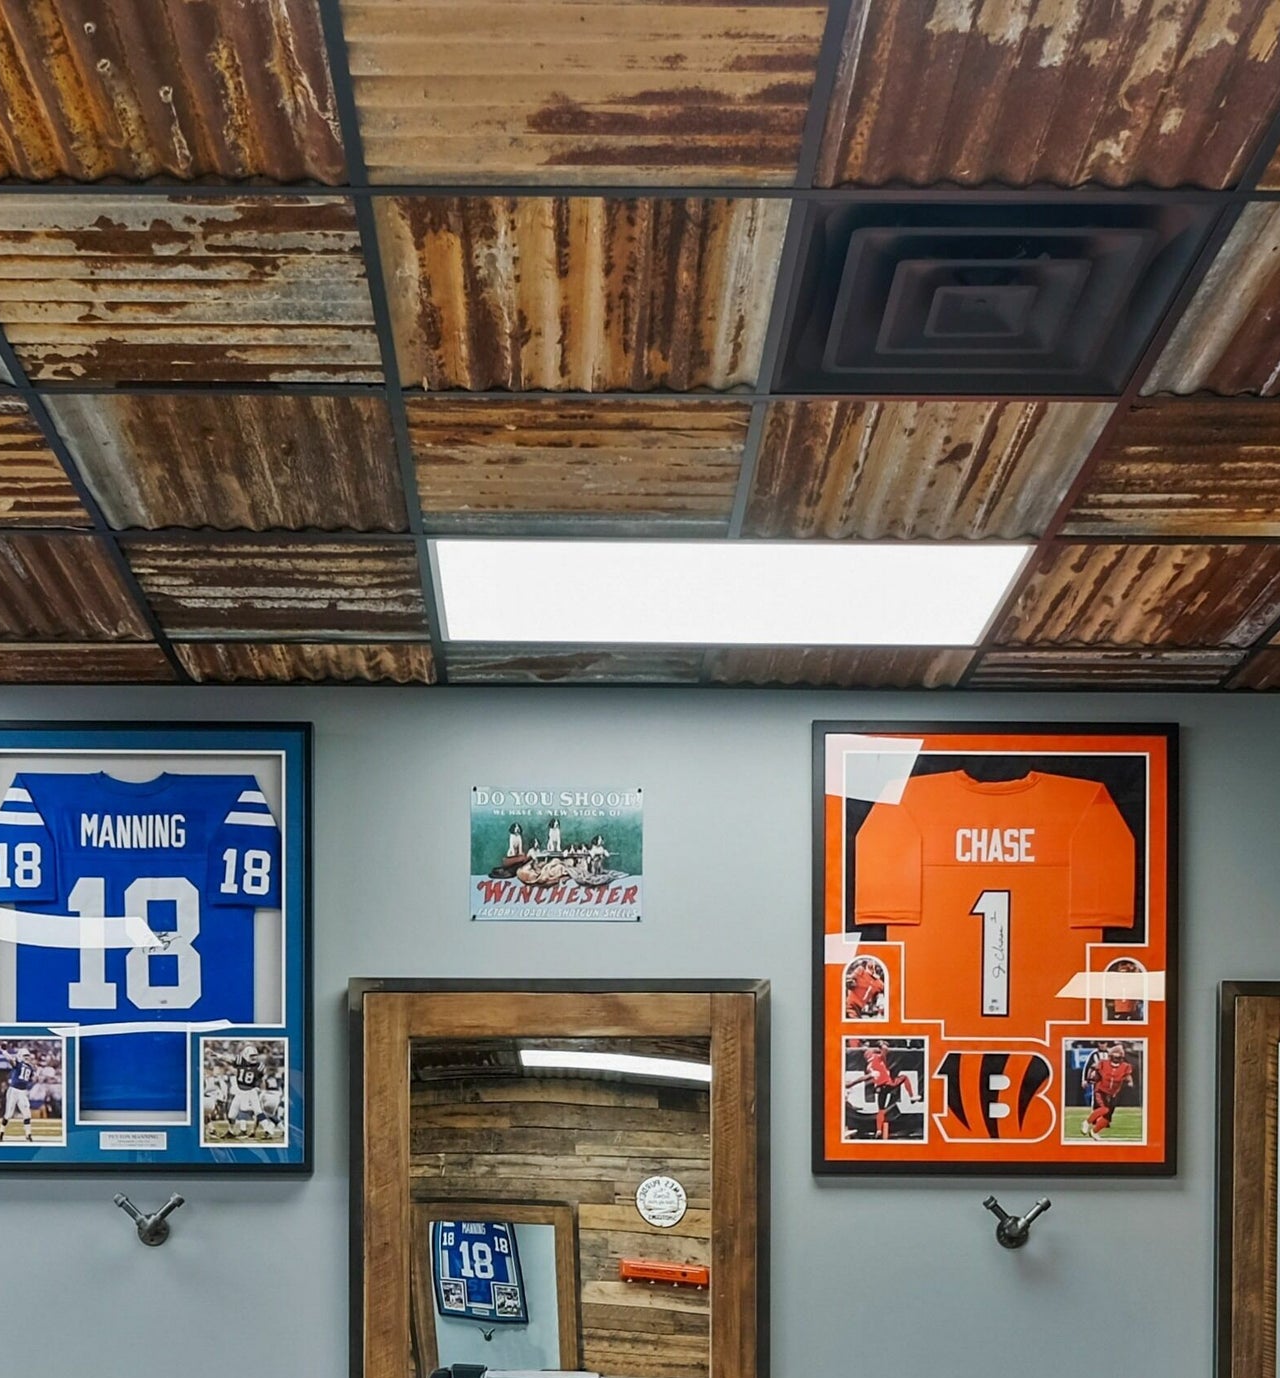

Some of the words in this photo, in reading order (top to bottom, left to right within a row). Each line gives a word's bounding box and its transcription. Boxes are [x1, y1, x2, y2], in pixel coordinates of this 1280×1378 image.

[476, 791, 504, 806] DO
[510, 791, 553, 806] YOU
[81, 813, 186, 848] MANNING
[956, 828, 1035, 862] CHASE
[220, 849, 271, 895] 18
[477, 880, 638, 905] WINCHESTER
[68, 877, 202, 1009] 18
[970, 889, 1011, 1017] 1
[18, 1066, 31, 1082] 18
[237, 1068, 255, 1085] 18
[442, 1232, 455, 1246] 18
[494, 1236, 509, 1254] 18
[459, 1241, 494, 1279] 18
